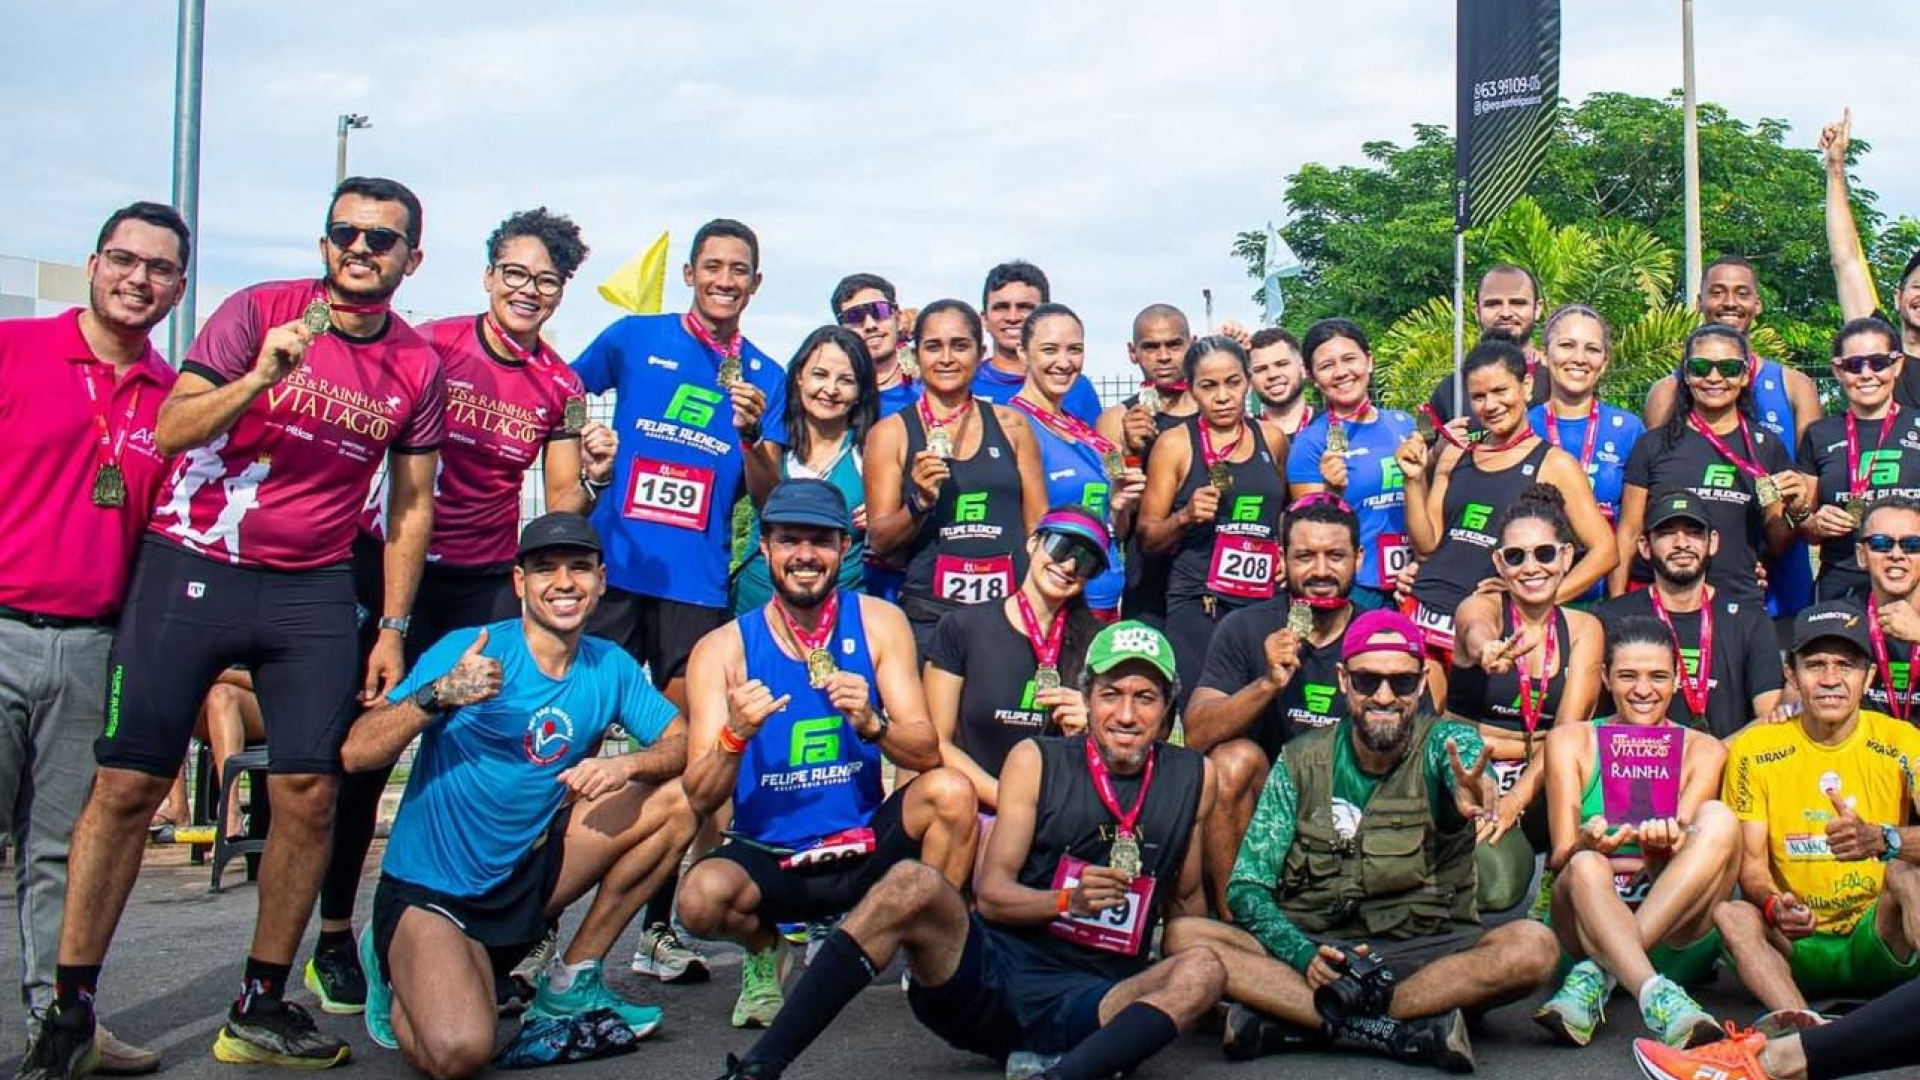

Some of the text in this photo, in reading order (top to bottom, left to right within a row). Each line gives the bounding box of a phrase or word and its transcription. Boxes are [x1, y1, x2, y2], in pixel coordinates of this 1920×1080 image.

[636, 418, 679, 436] FELIPE
[642, 478, 697, 508] 159
[1224, 553, 1268, 580] 208
[949, 577, 1003, 601] 218
[761, 769, 809, 787] FELIPE
[1611, 762, 1669, 779] RAINHA
